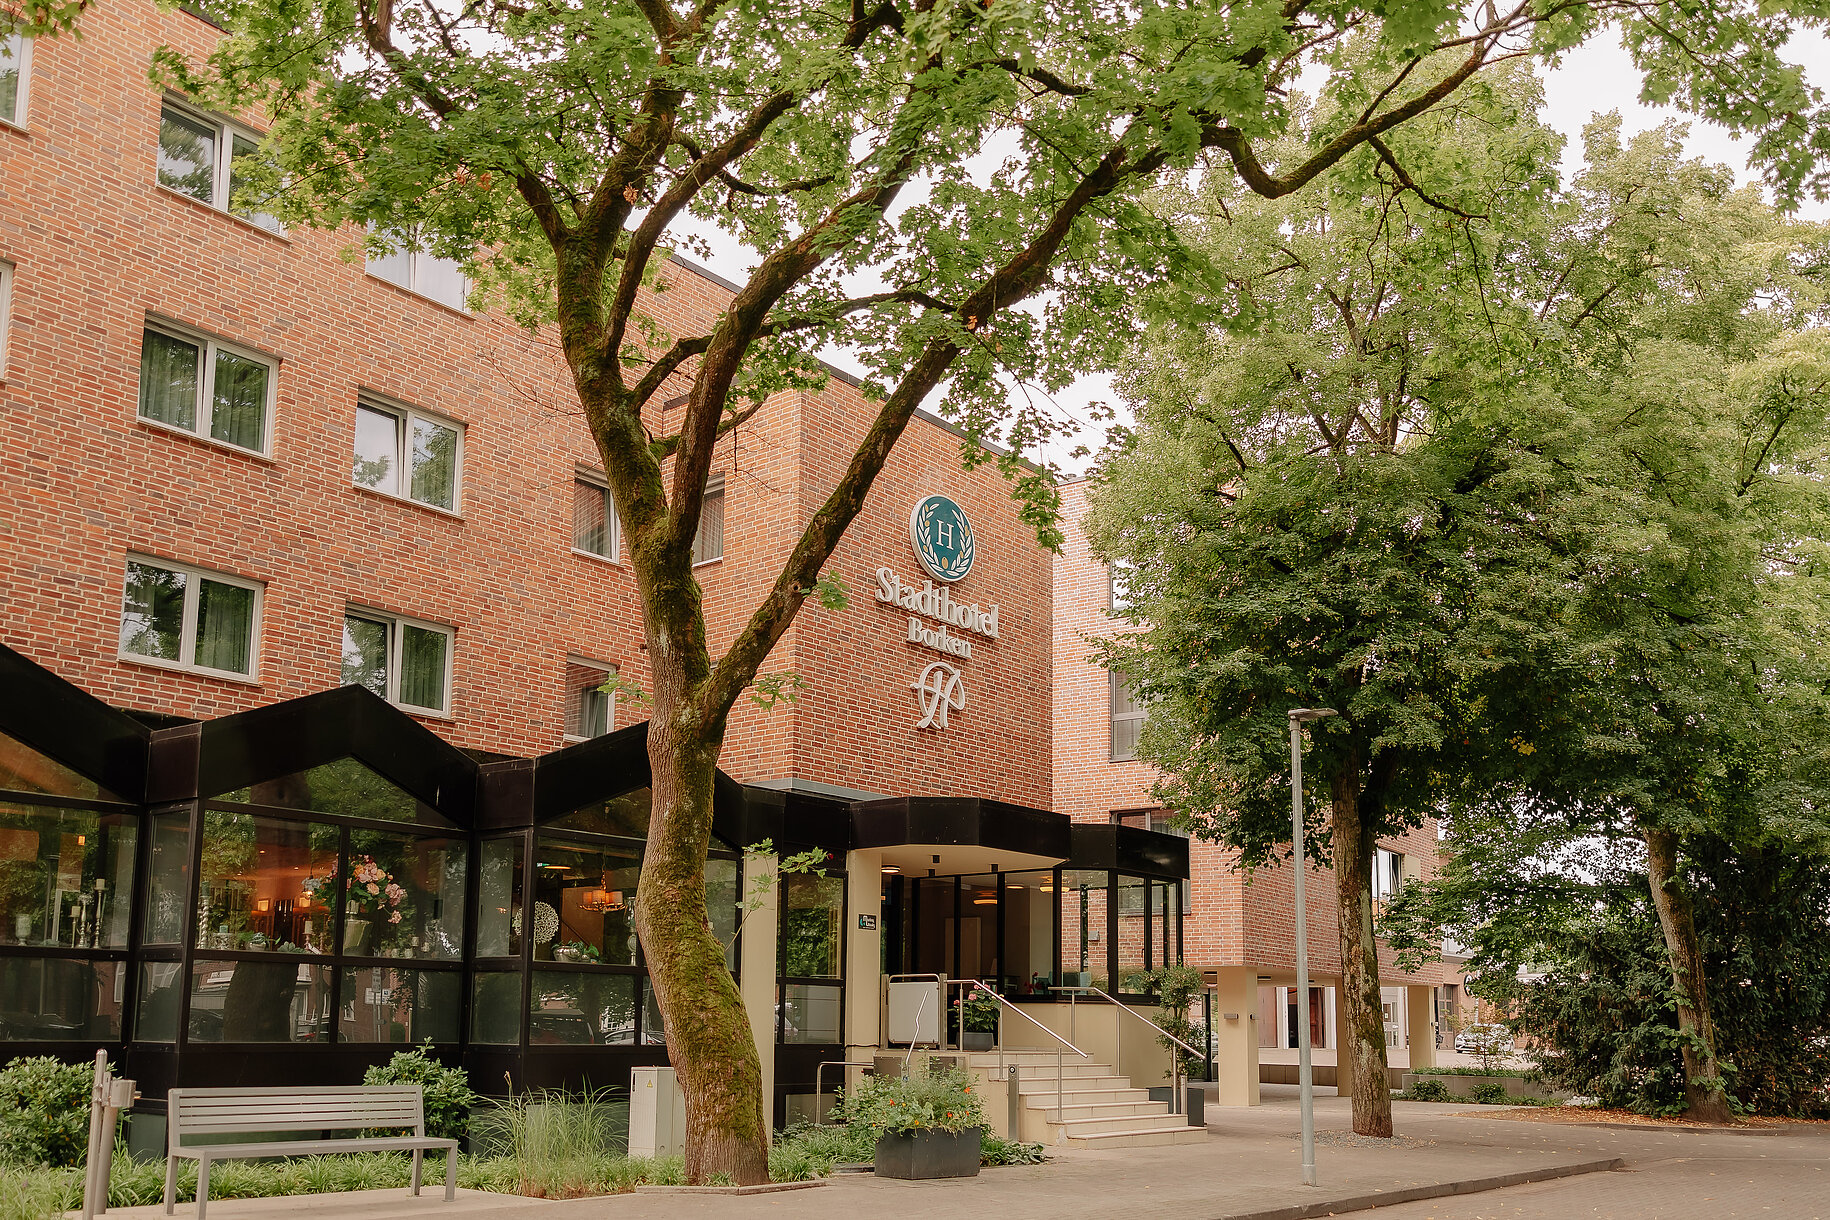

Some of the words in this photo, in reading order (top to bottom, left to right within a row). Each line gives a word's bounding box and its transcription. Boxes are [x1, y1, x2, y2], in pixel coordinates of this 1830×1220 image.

[936, 519, 954, 550] H
[875, 567, 1001, 640] Stadthotel
[906, 617, 972, 660] Borken
